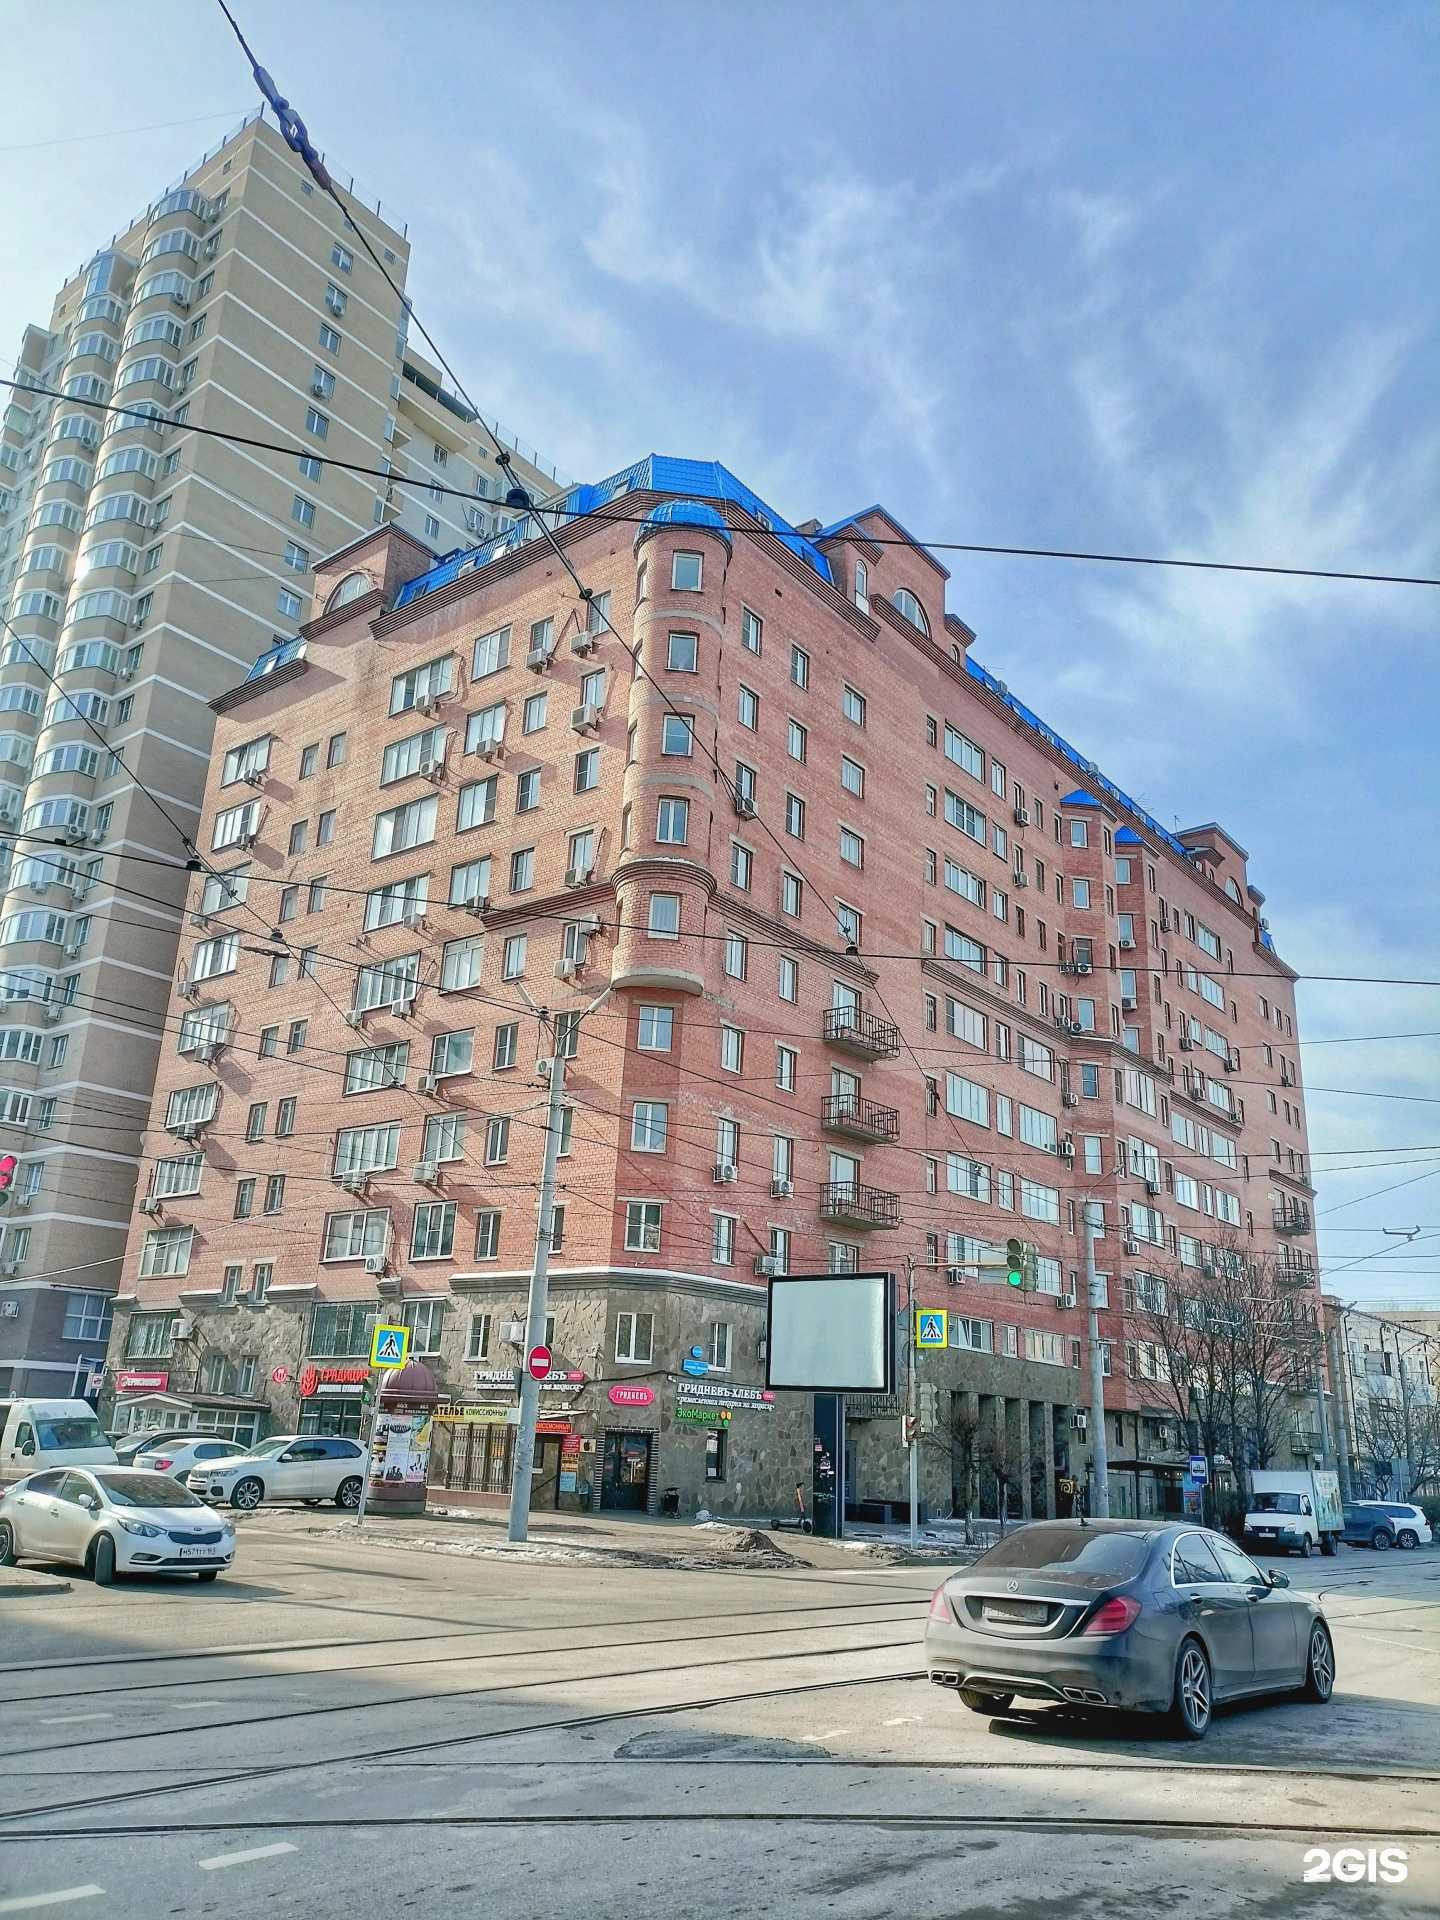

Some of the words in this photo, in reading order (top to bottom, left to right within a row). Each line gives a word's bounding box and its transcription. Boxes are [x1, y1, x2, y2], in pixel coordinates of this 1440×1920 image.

[616, 1391, 648, 1401] ГРИДНЕВЪ
[433, 1406, 464, 1416] АТЕЛЬЕ
[465, 1408, 507, 1416] КОМИССИОННЫЙ
[677, 1408, 721, 1421] ЭкоМаркет
